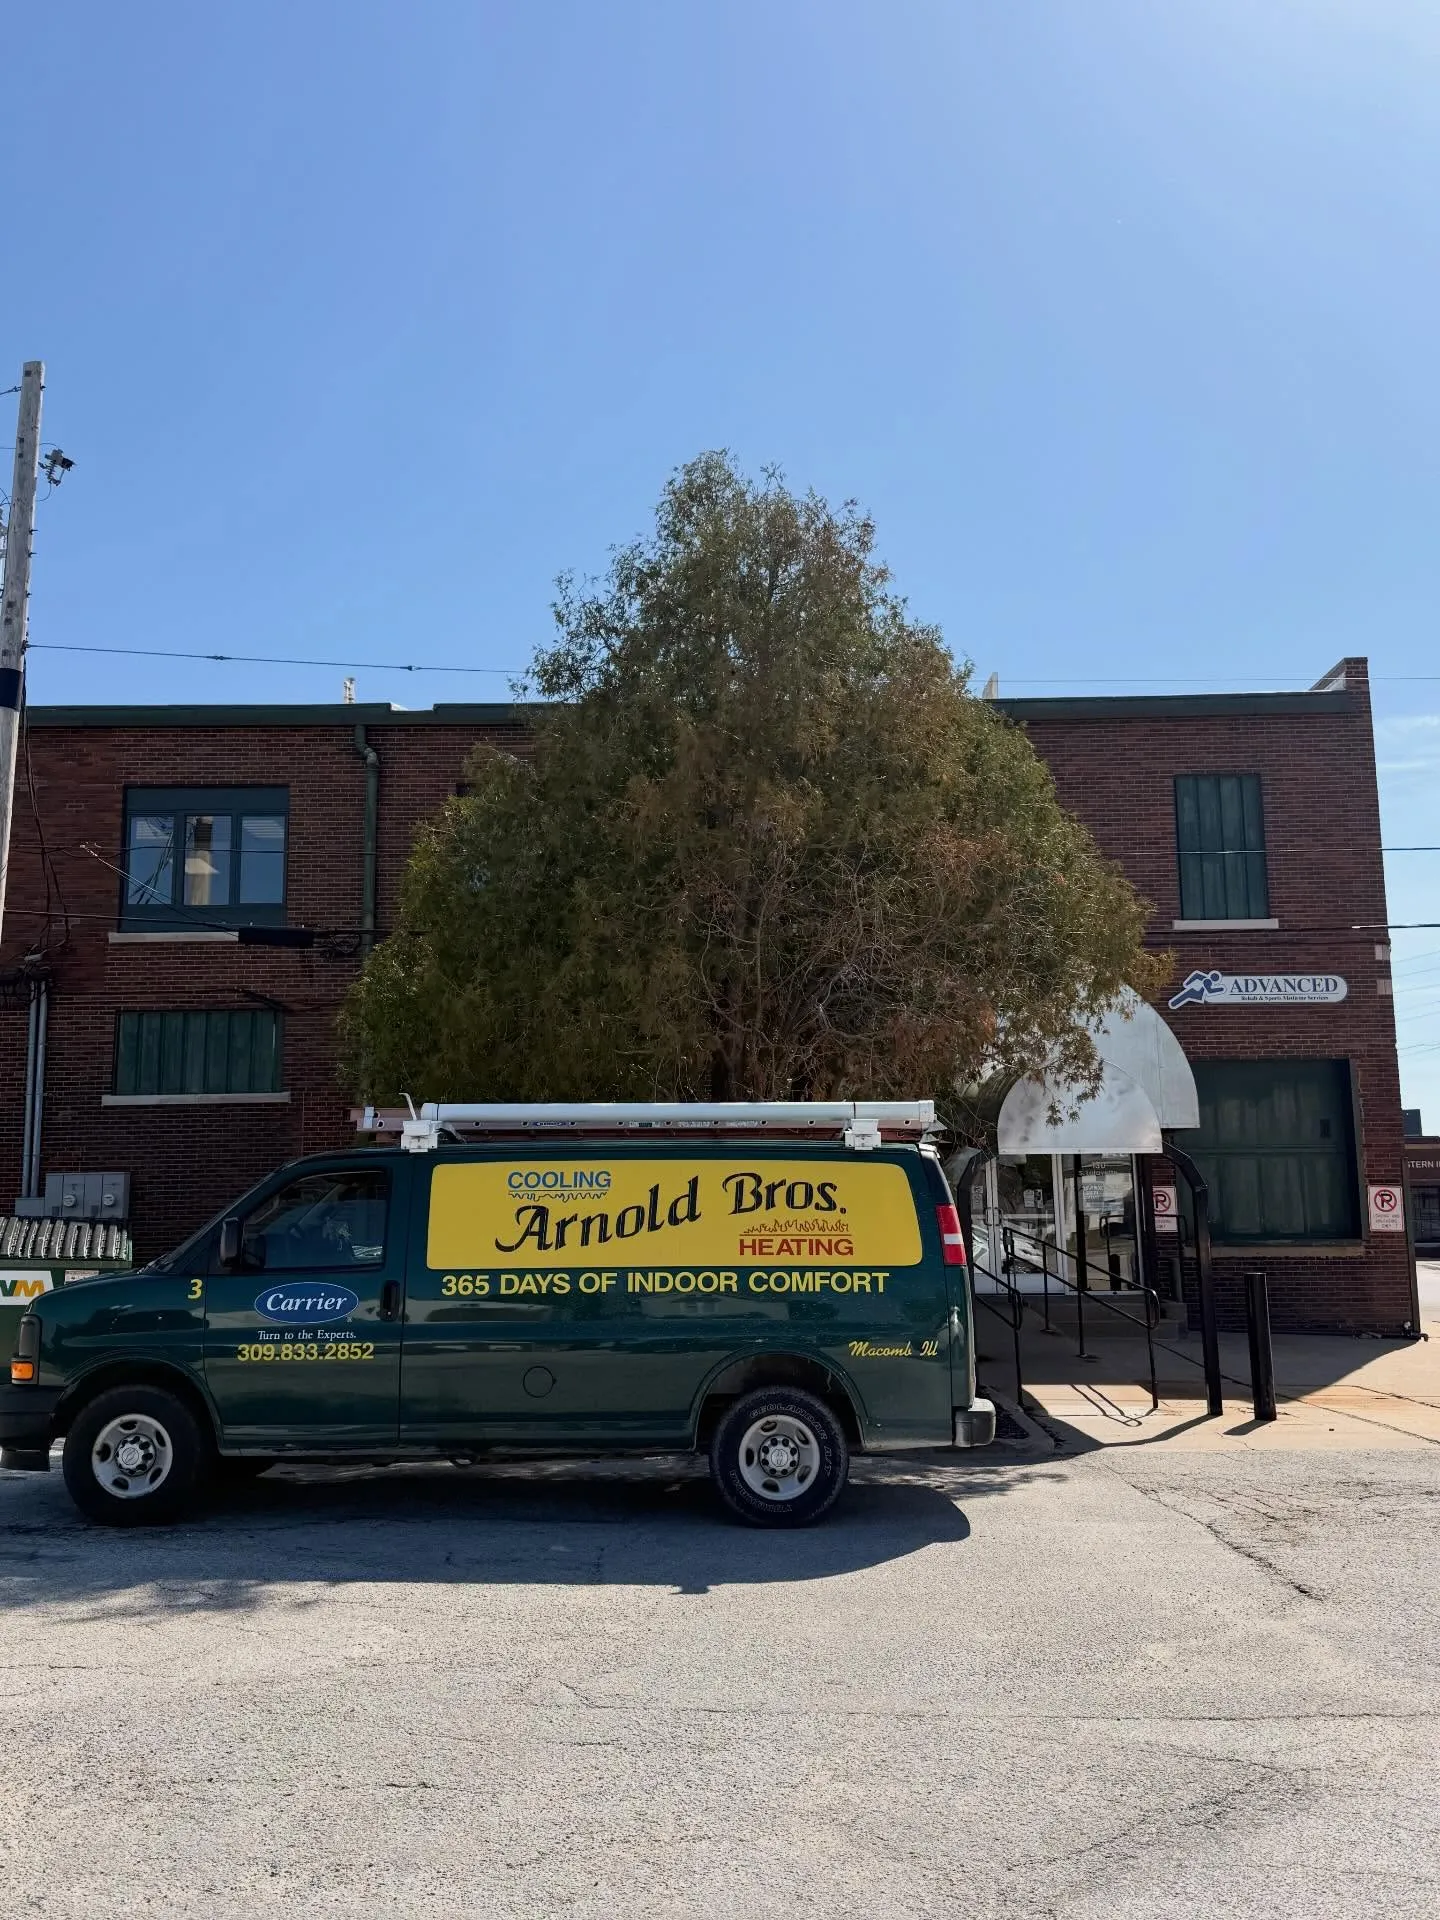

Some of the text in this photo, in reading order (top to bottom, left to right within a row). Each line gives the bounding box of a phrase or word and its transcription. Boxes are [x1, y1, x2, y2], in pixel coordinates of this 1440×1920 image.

[1230, 977, 1338, 993] ADVANCED
[508, 1170, 611, 1189] COOLING
[495, 1172, 847, 1252] Arnold Bros.
[739, 1238, 854, 1256] HEATING
[187, 1278, 203, 1299] 3
[442, 1271, 890, 1295] 365 DAYS OF INDOOR COMFORT
[266, 1292, 348, 1311] Carrier
[257, 1329, 357, 1341] Turn to the Experts.
[237, 1342, 375, 1361] 309.833.2852
[848, 1340, 912, 1357] Macomb
